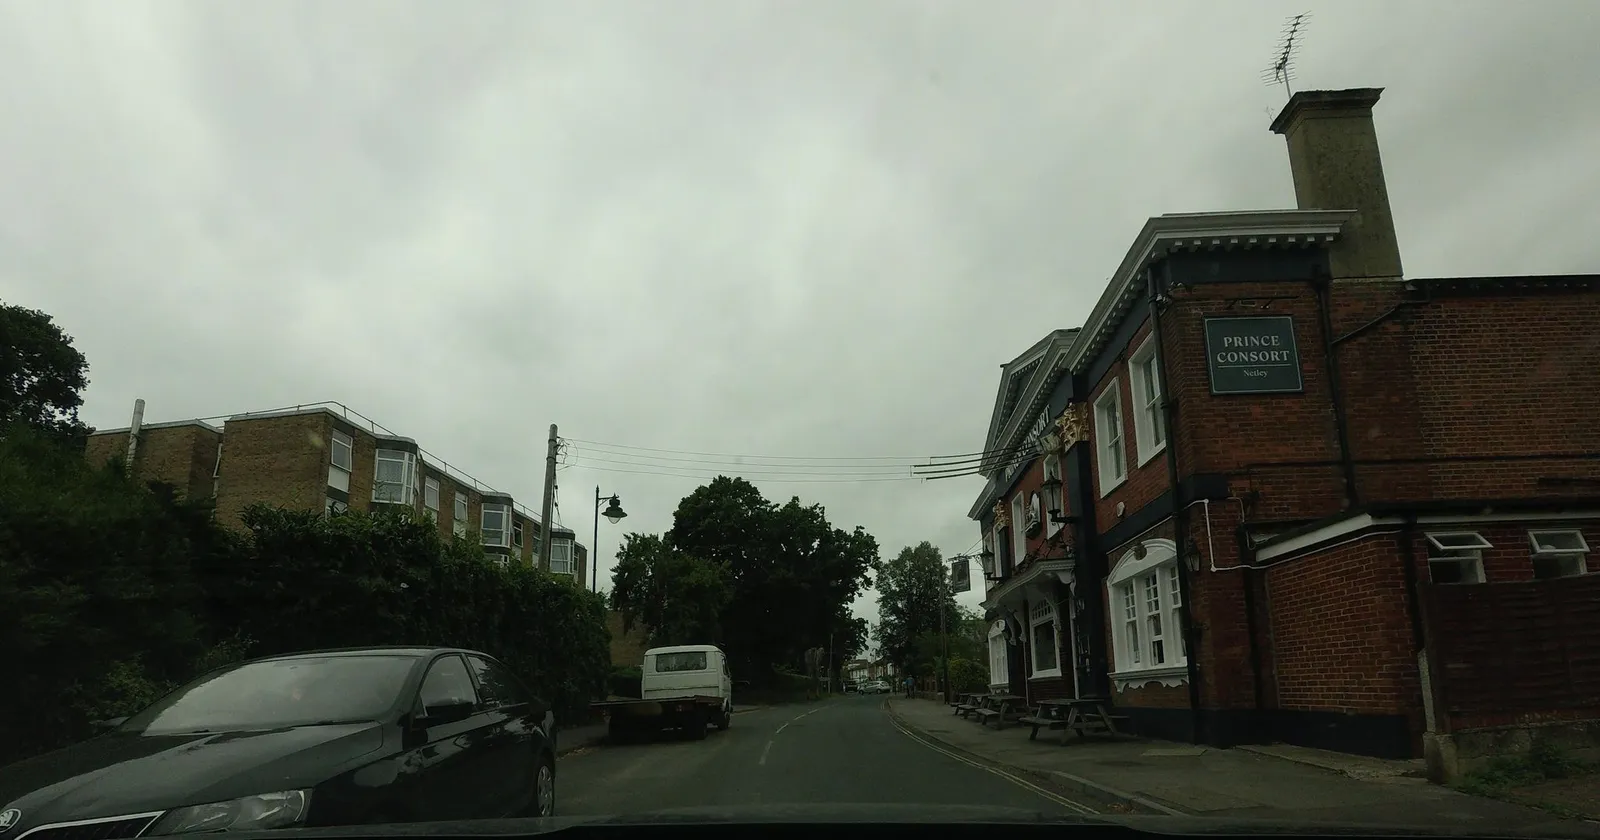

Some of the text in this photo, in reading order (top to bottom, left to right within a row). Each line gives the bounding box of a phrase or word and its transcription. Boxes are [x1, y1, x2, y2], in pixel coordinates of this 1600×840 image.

[1223, 335, 1280, 347] PRINCE
[1216, 350, 1290, 363] CONSORT
[1243, 369, 1268, 378] Netley
